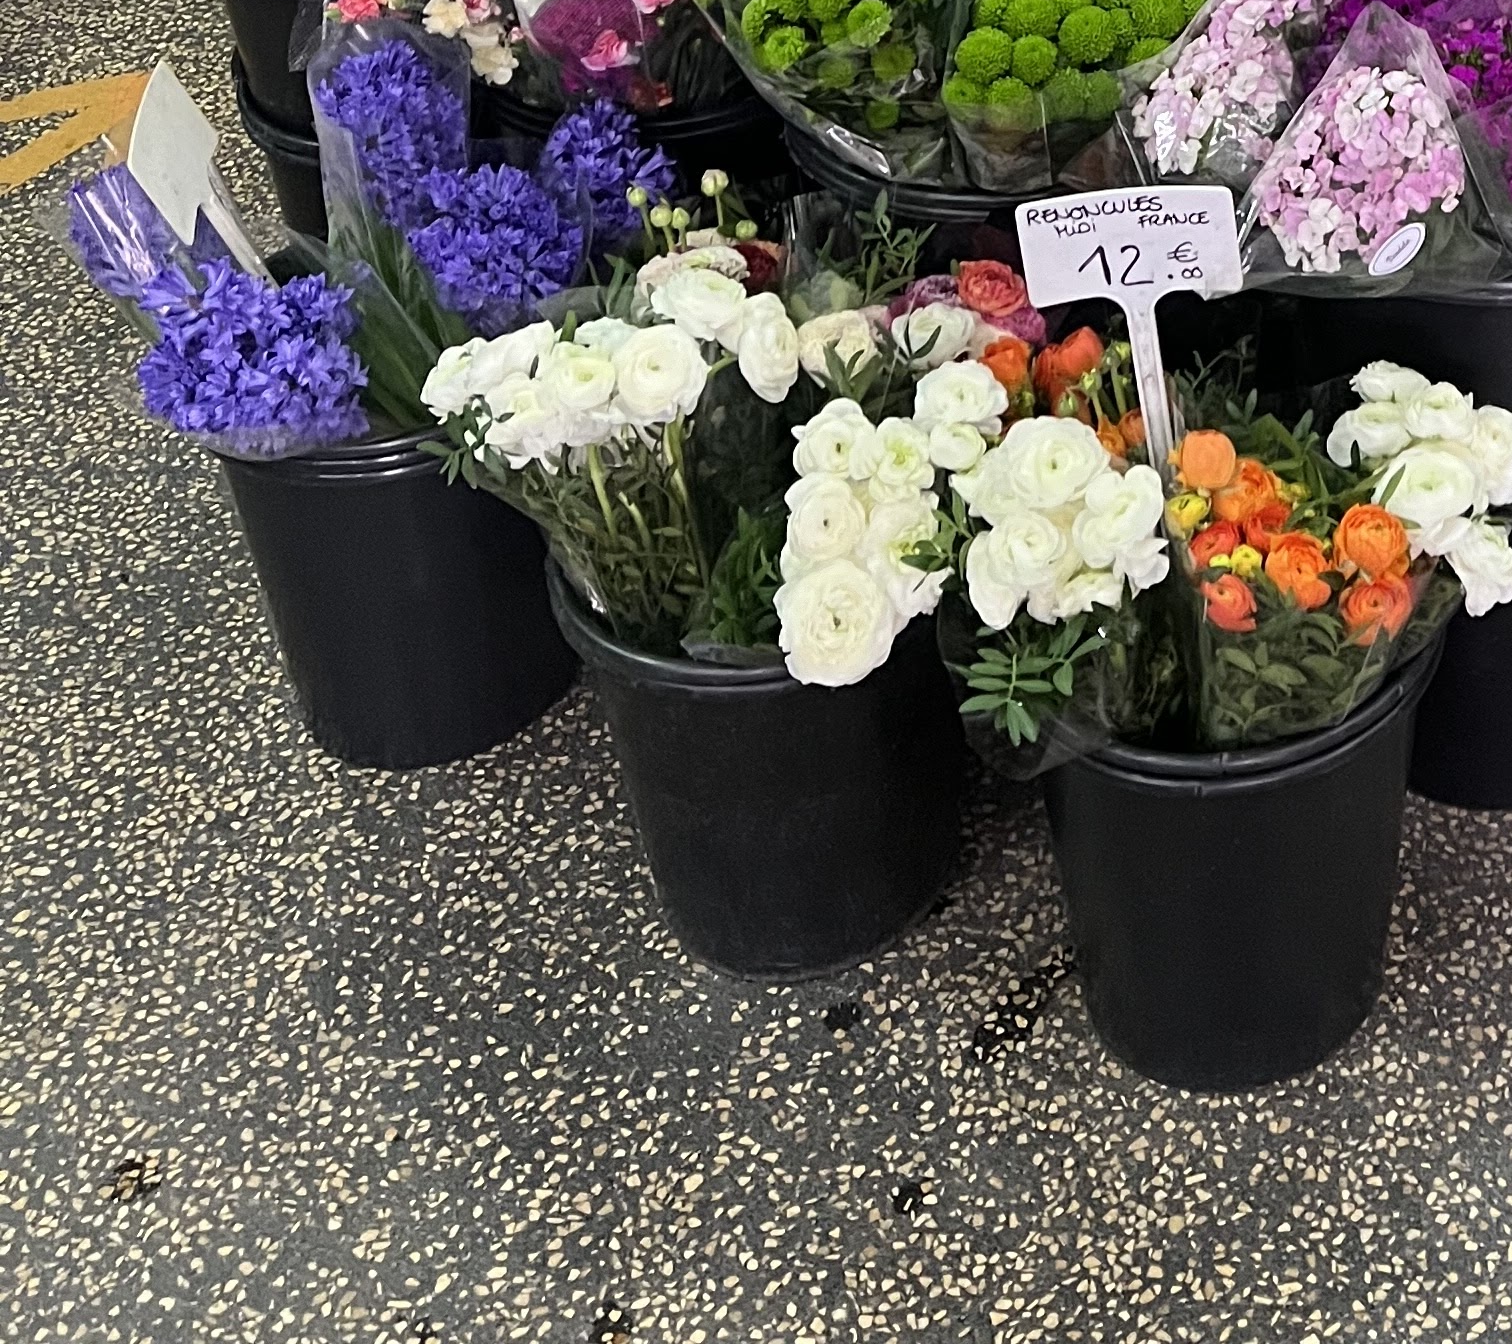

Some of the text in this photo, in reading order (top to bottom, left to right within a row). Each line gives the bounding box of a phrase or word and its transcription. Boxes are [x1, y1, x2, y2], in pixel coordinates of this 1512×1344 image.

[1027, 196, 1163, 226] RENONCULES
[1138, 211, 1210, 229] FRANCE
[1078, 245, 1154, 286] 12
[1167, 241, 1198, 262] €
